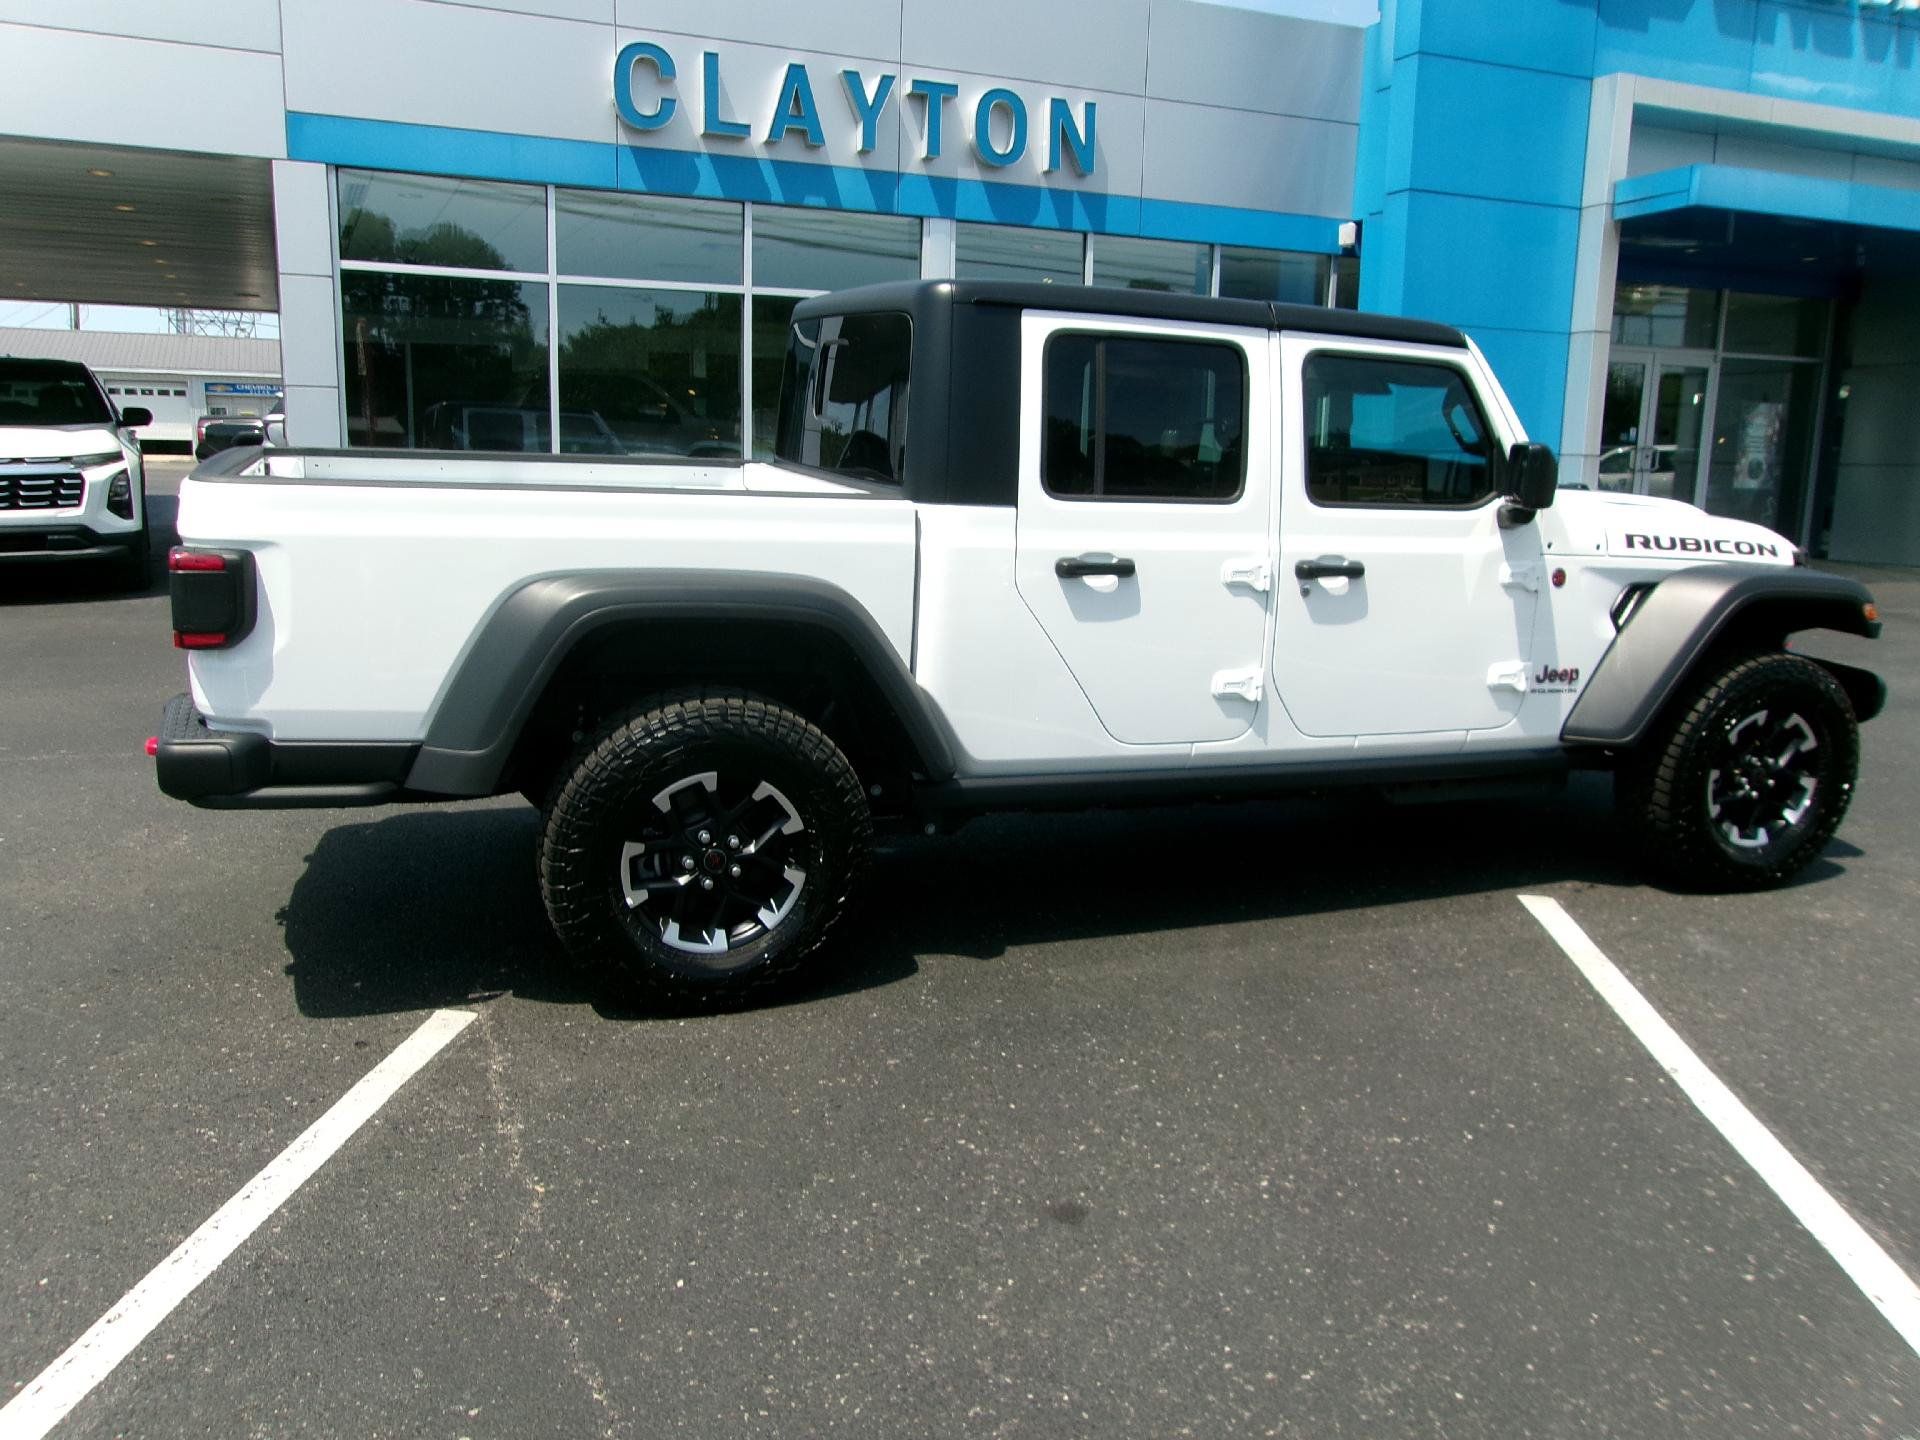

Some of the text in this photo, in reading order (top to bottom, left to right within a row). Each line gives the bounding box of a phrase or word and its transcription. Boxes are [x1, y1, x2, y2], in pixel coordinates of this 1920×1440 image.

[613, 41, 1097, 175] CLAYTON
[1625, 533, 1779, 557] RUBICON
[1535, 664, 1579, 685] Jeep
